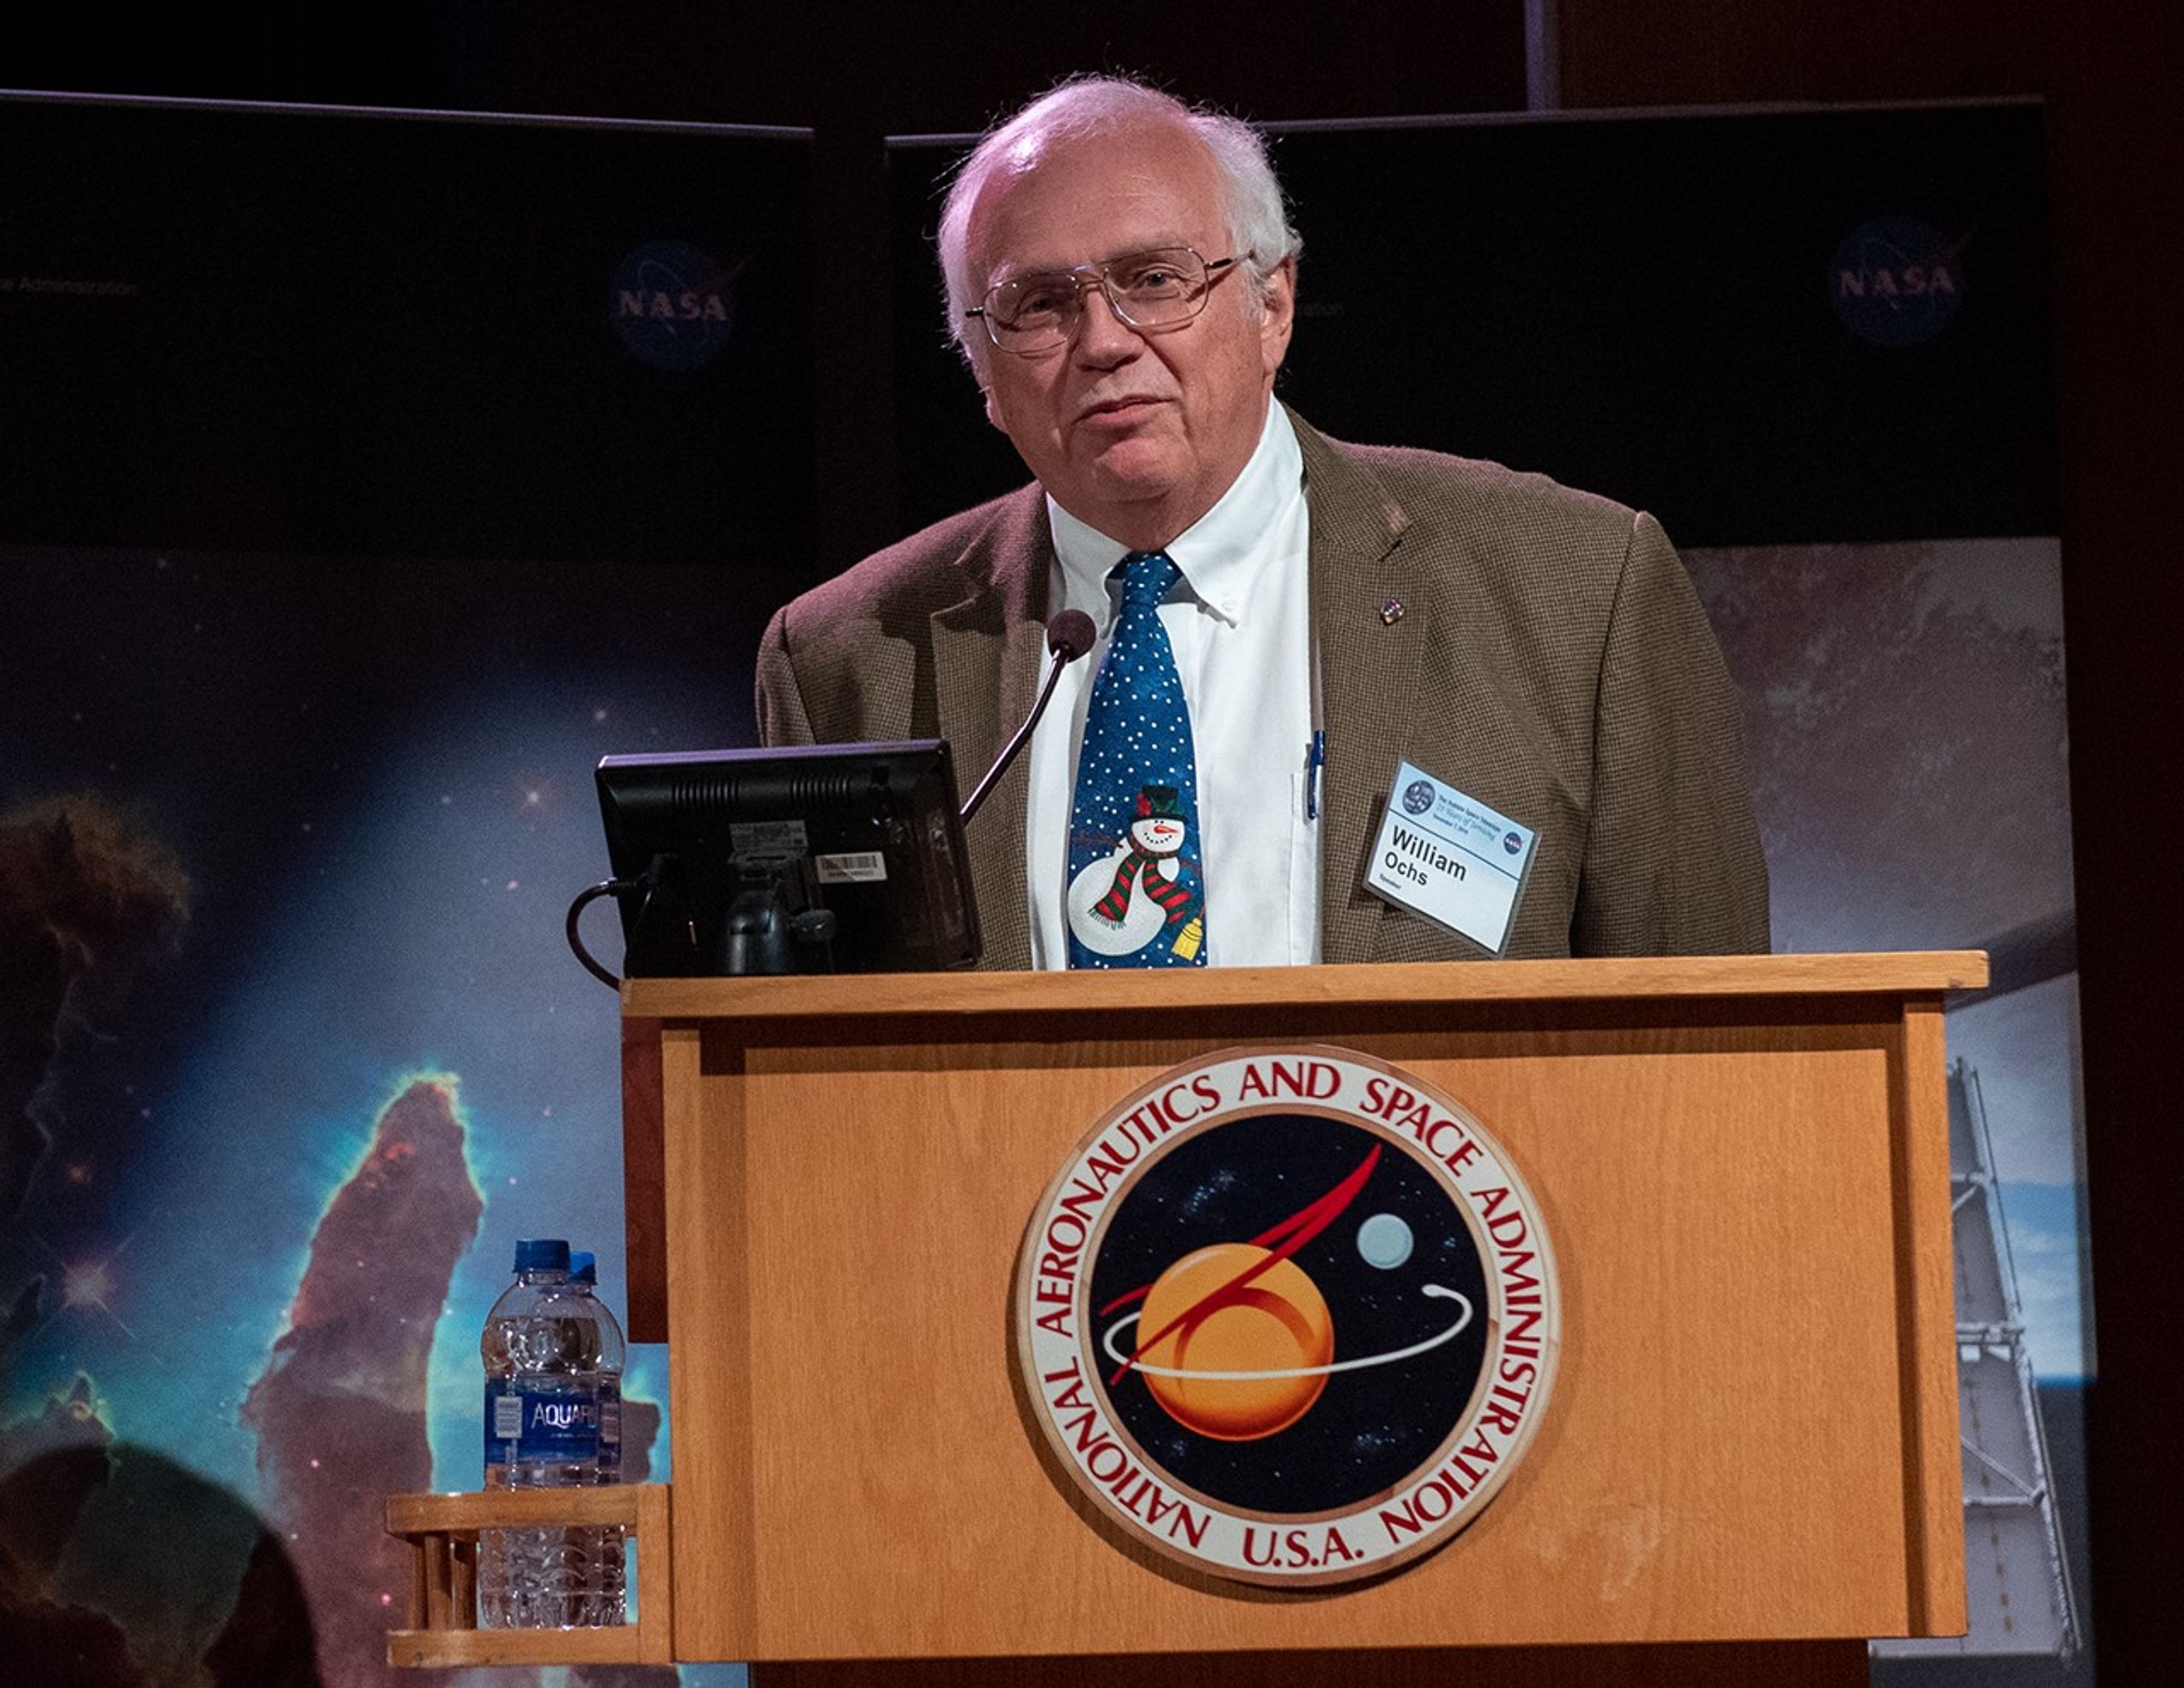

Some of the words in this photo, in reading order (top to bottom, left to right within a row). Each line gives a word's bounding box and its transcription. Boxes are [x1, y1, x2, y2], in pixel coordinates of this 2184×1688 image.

[619, 289, 729, 322] NASA
[1839, 265, 1956, 297] NASA
[1385, 851, 1428, 886] Ochs
[1392, 824, 1467, 882] William
[1239, 1061, 1342, 1100] AND
[1359, 1078, 1484, 1177] SPACE
[1036, 1075, 1220, 1337] AERONAUTICS
[1379, 1187, 1542, 1544] ADMINISTRATION
[1044, 1356, 1211, 1548] NATIONAL
[1243, 1528, 1364, 1568] U.S.A.
